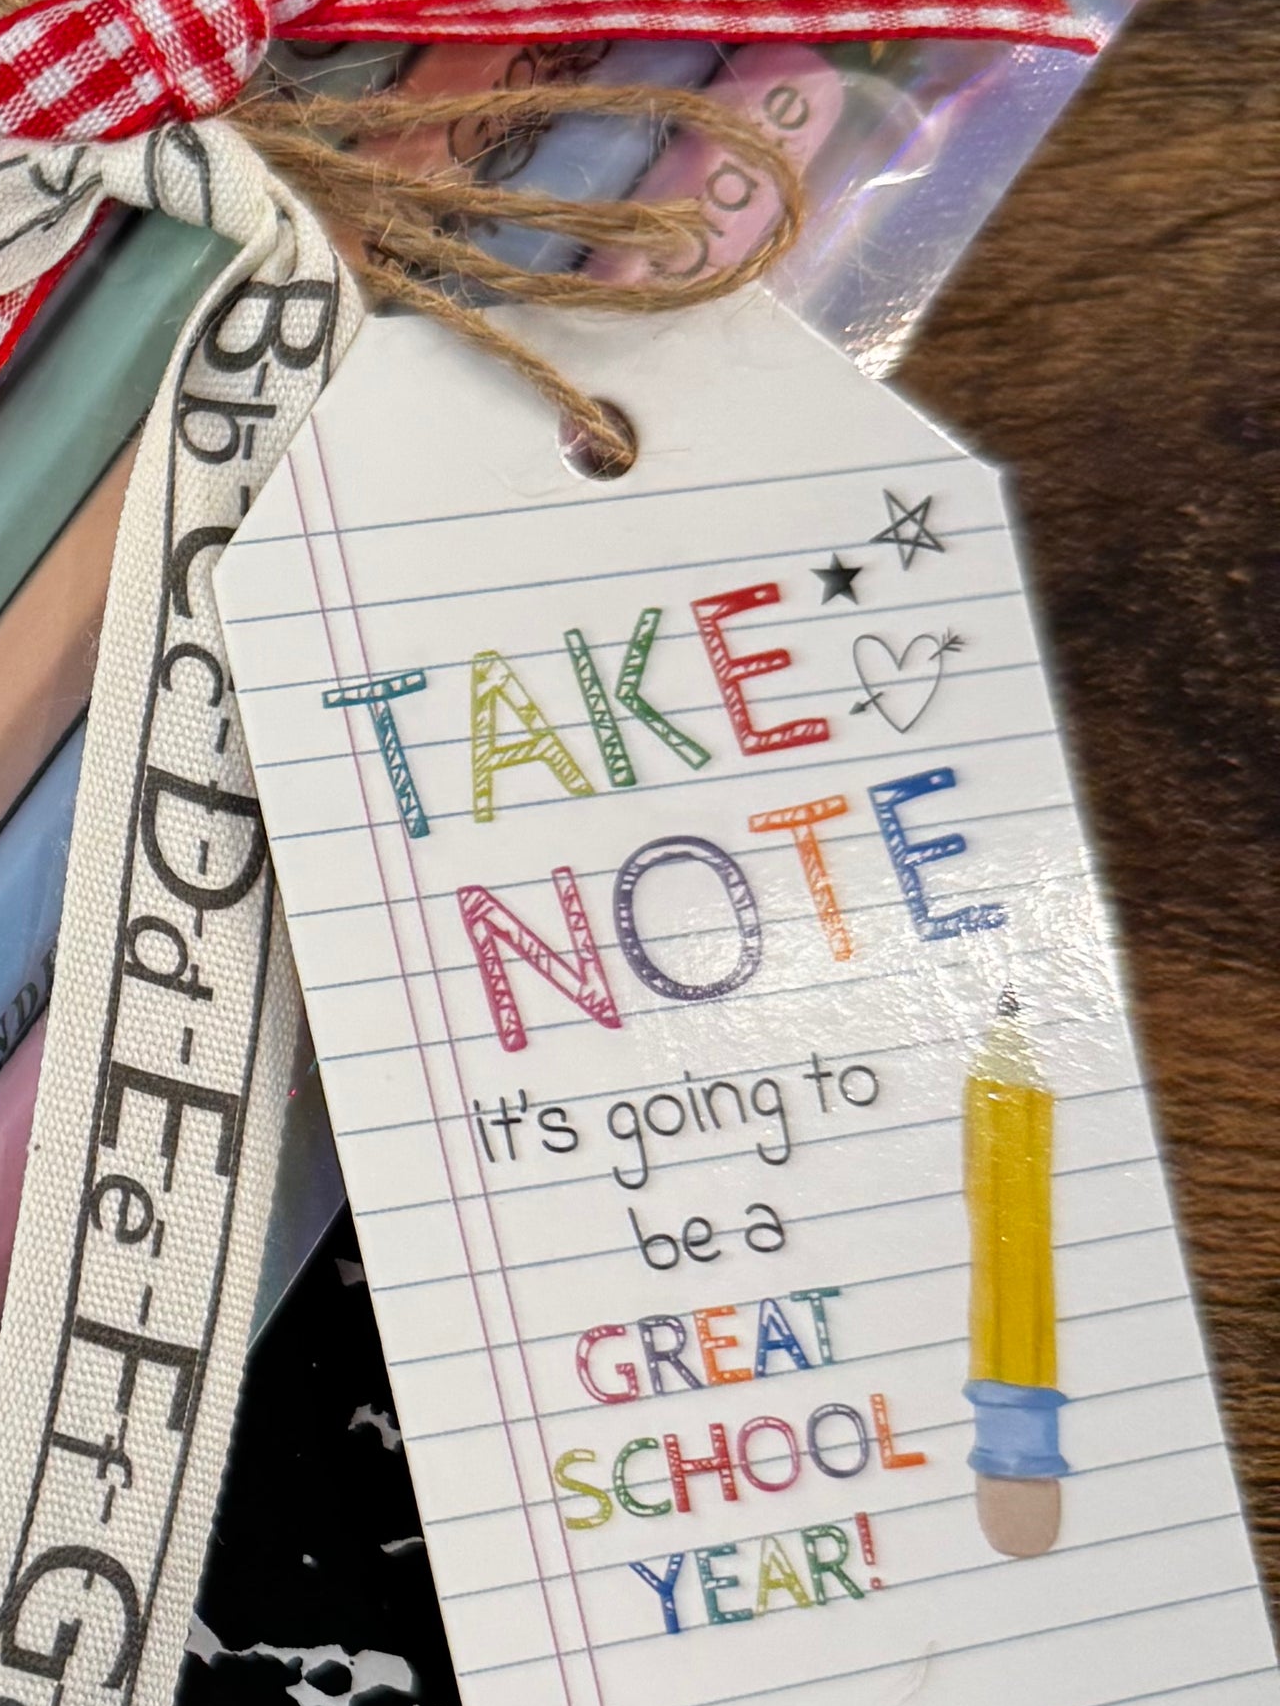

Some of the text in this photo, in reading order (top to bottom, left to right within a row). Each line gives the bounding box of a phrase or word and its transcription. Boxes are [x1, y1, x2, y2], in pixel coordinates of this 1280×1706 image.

[324, 582, 831, 838] TAKE
[455, 767, 1005, 1053] NOTE
[608, 1068, 785, 1191] going
[800, 1055, 881, 1113] to
[636, 1201, 788, 1269] be a
[574, 1289, 841, 1404] GREAT
[550, 1393, 926, 1531] SCHOOL
[627, 1512, 886, 1635] YEAR!
